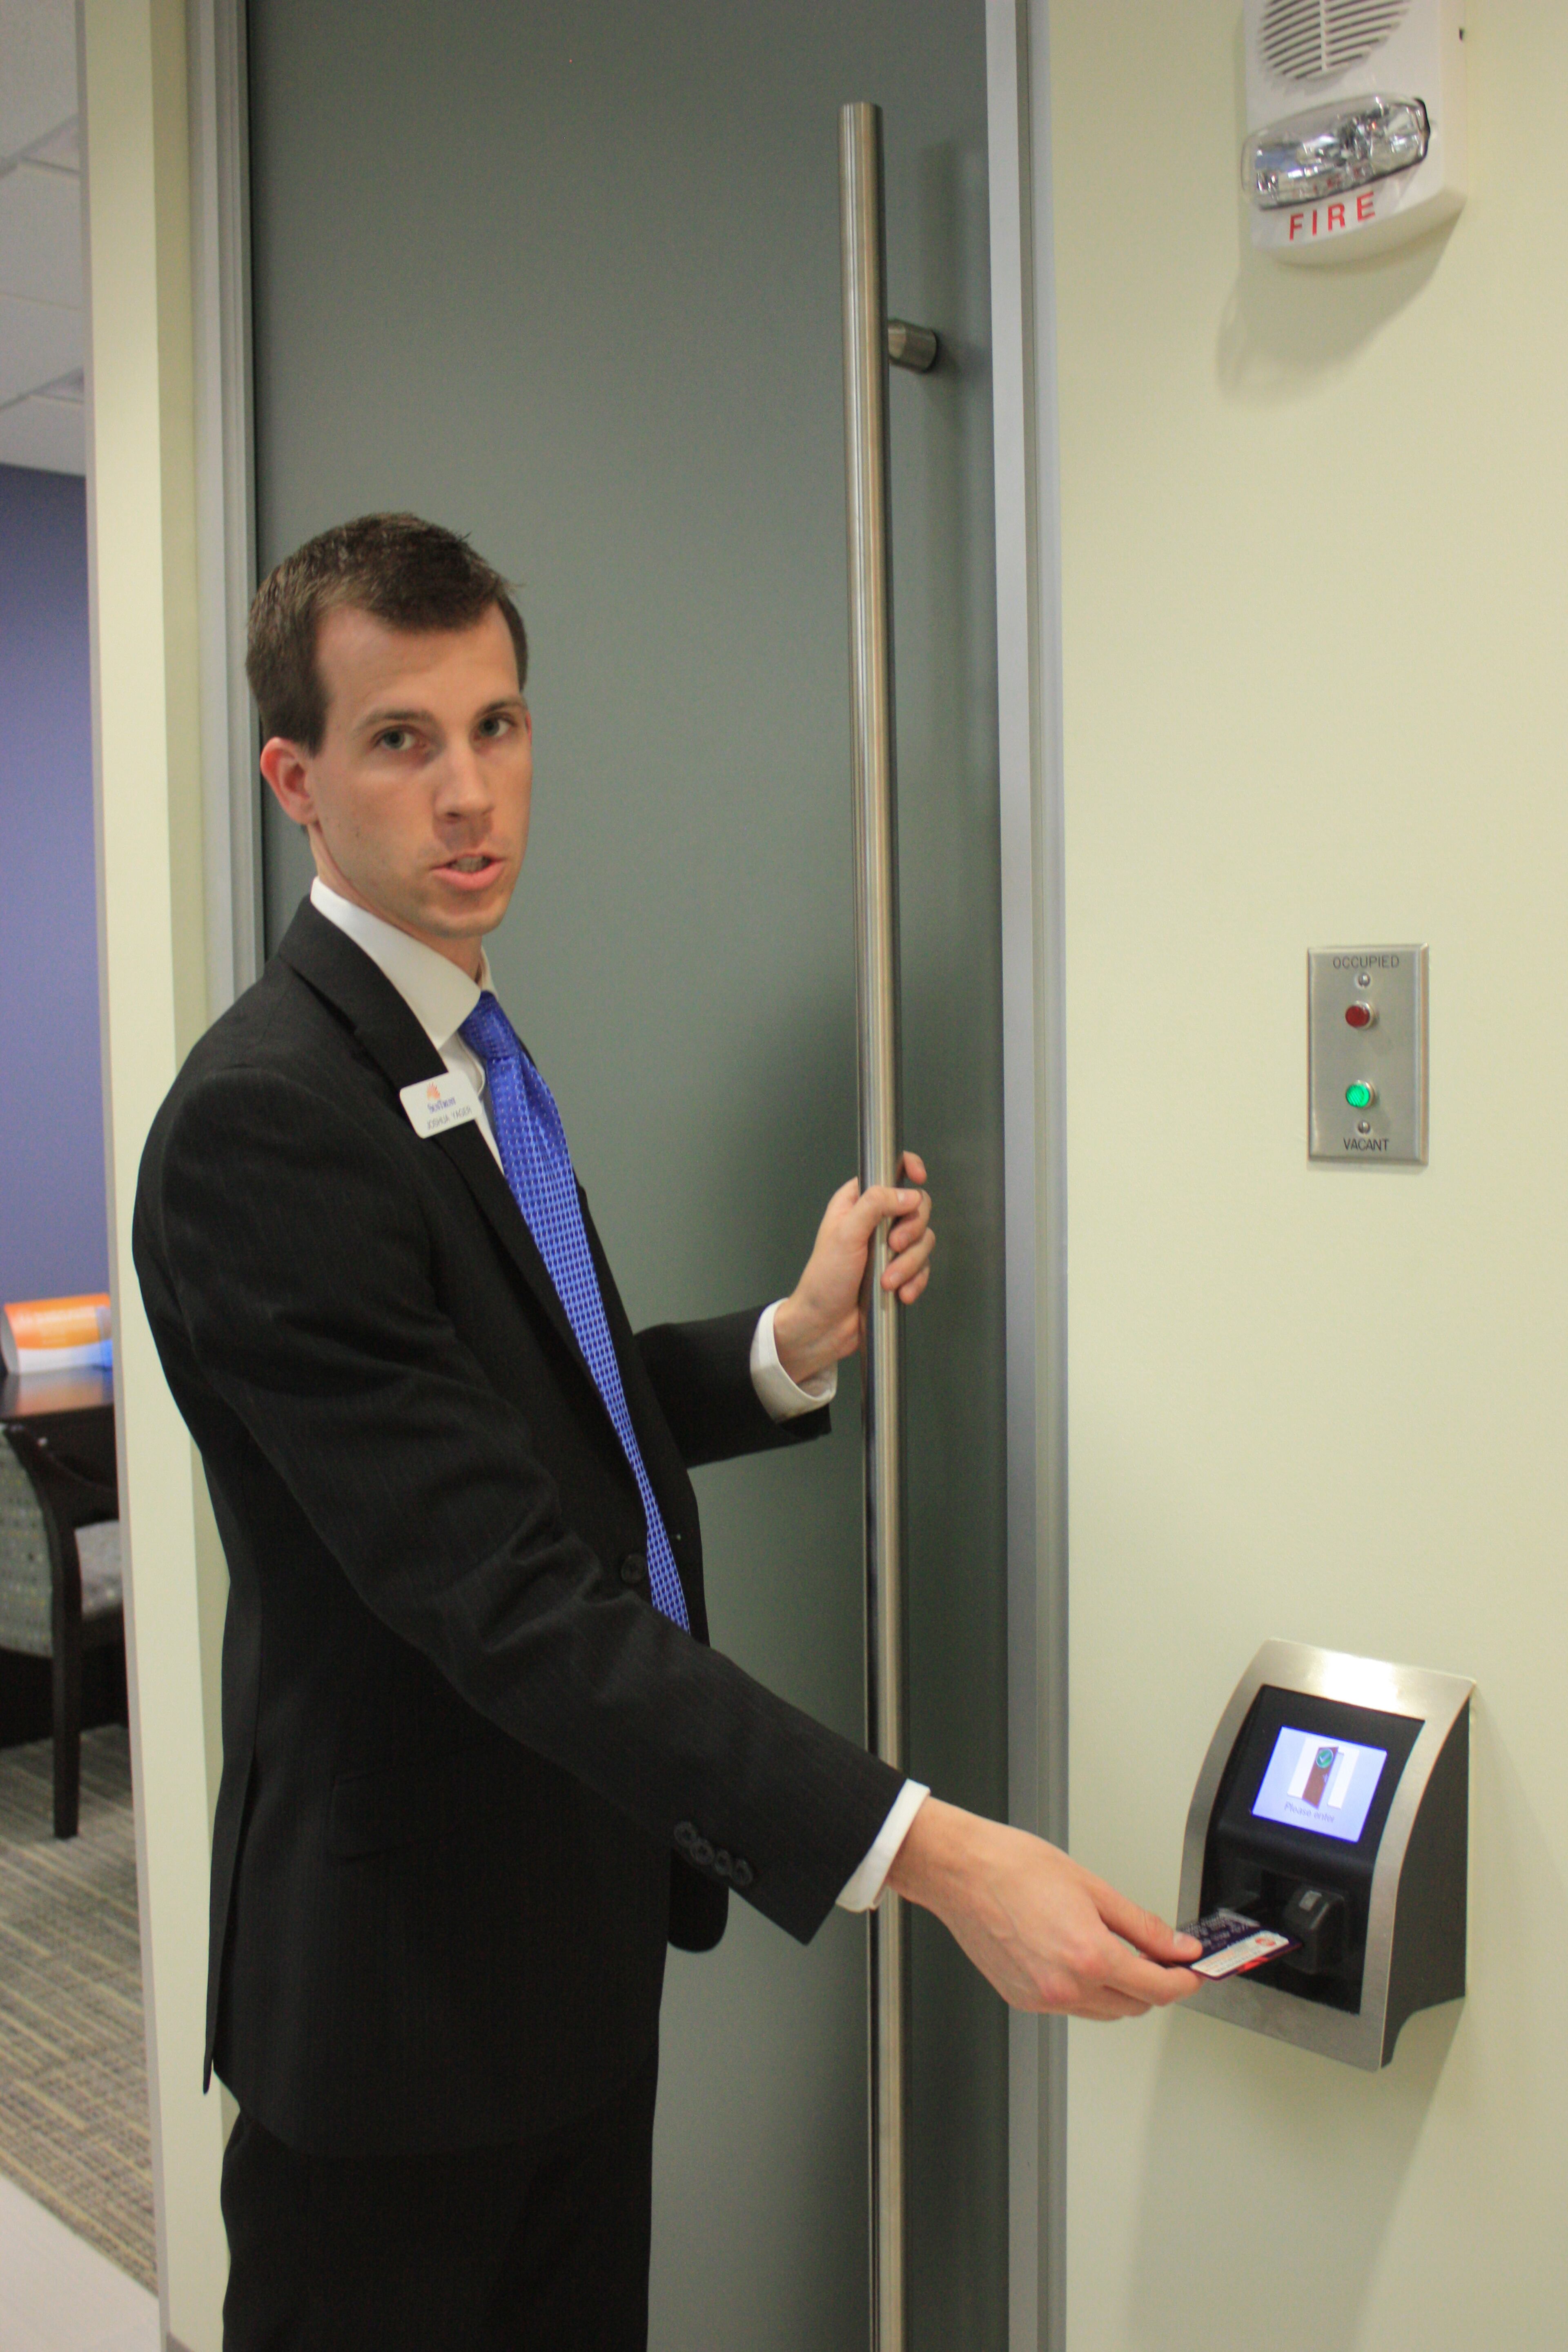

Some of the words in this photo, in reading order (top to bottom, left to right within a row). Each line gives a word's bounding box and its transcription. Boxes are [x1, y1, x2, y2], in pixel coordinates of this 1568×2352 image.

[1289, 191, 1375, 241] FIRE
[1333, 955, 1399, 968] OCCUPIED
[1343, 1138, 1389, 1151] VACANT
[1284, 1801, 1311, 1816] Please
[1314, 1811, 1334, 1822] enter
